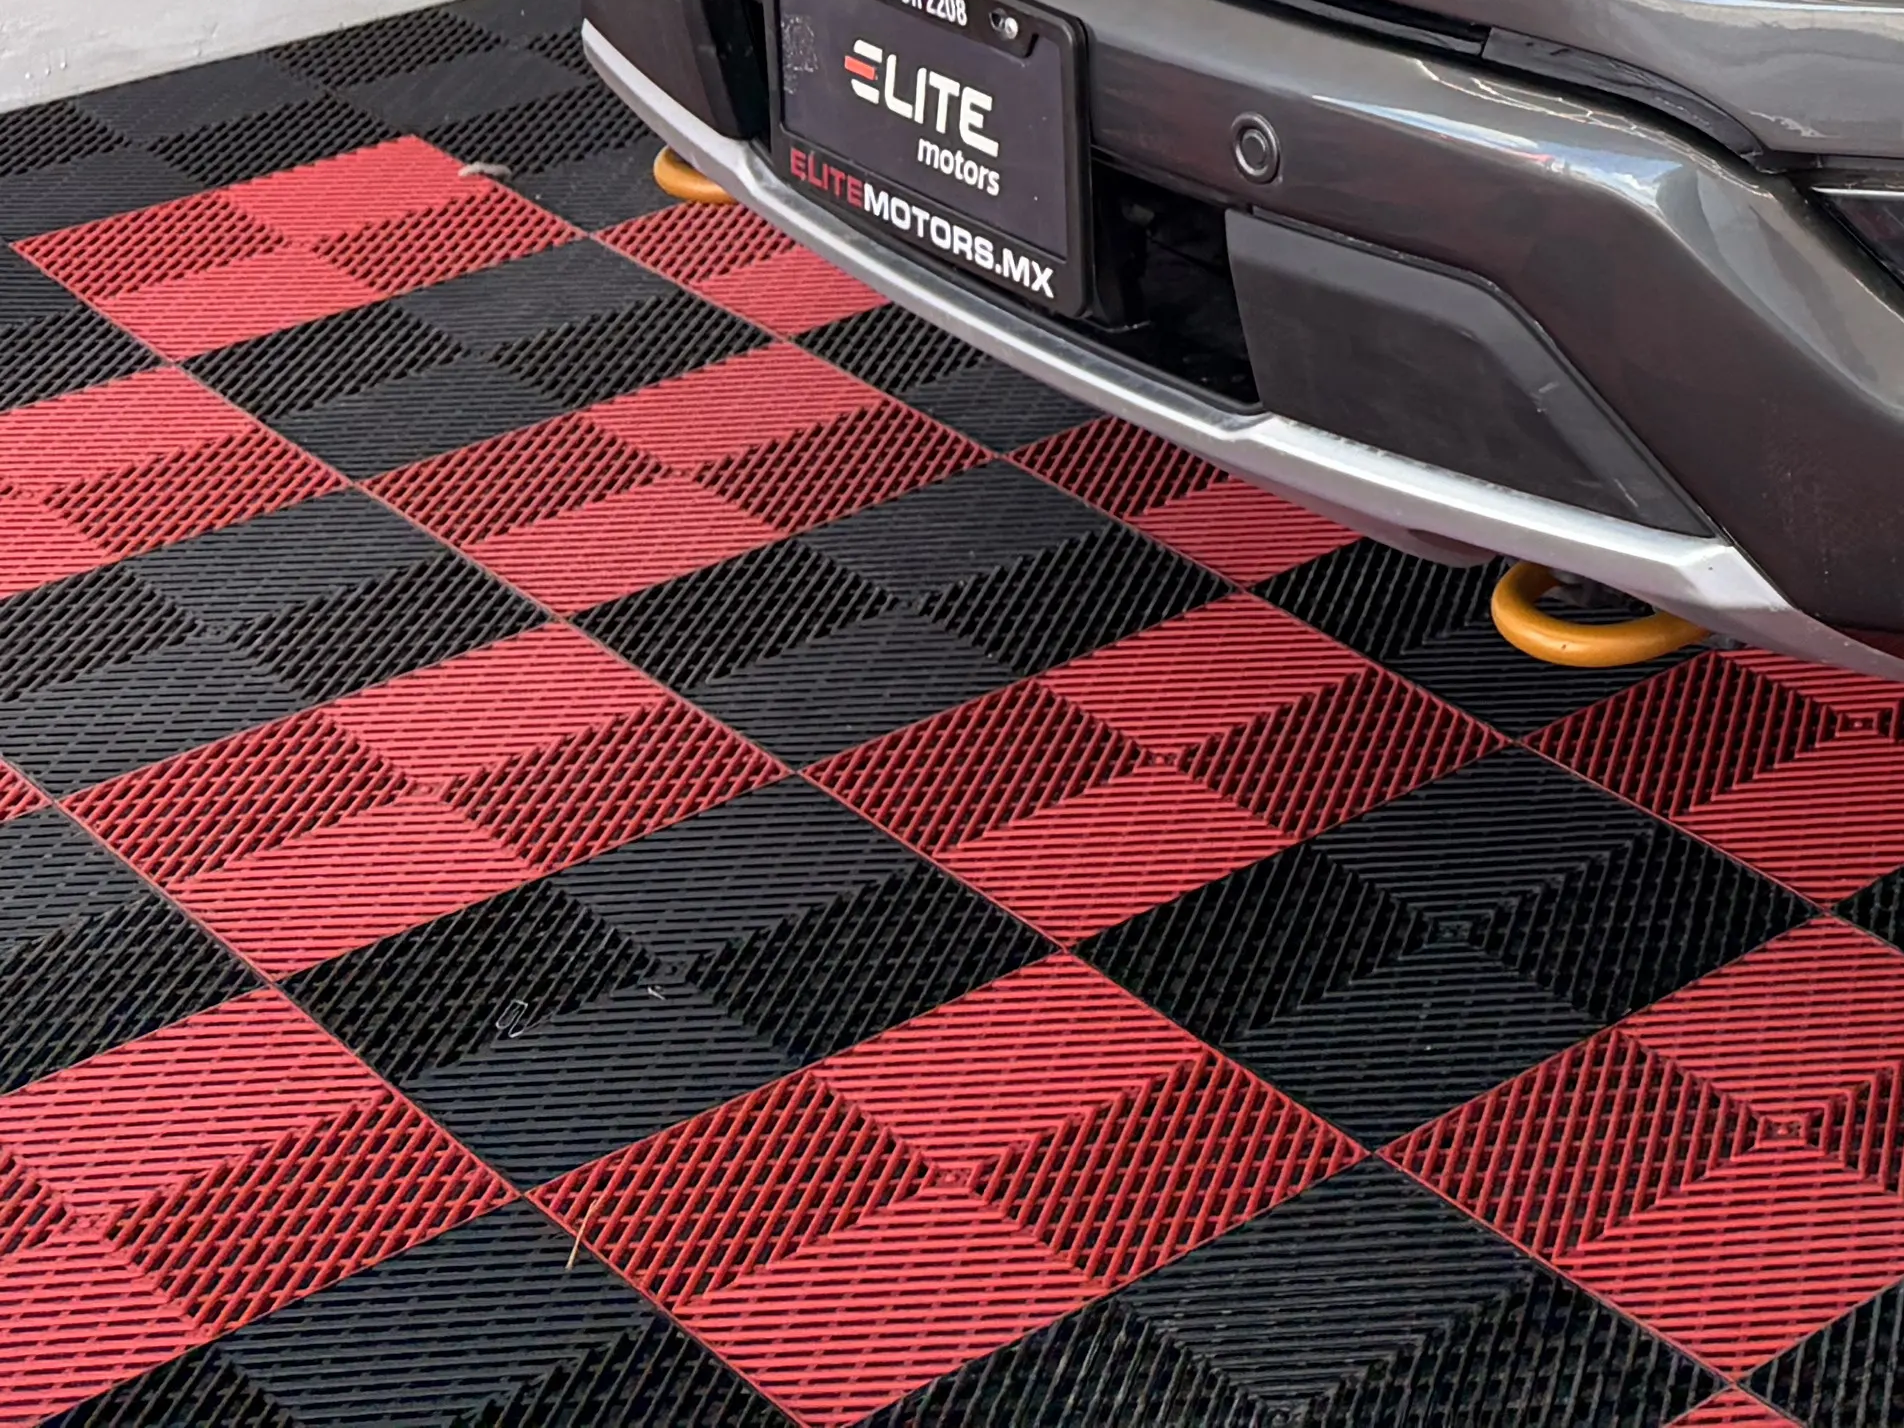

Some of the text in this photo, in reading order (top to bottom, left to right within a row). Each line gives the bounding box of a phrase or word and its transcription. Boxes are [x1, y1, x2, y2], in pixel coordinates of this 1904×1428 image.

[845, 39, 999, 157] ELITE
[790, 147, 1055, 298] ELITEMOTORS.MX
[917, 138, 1000, 197] motors
